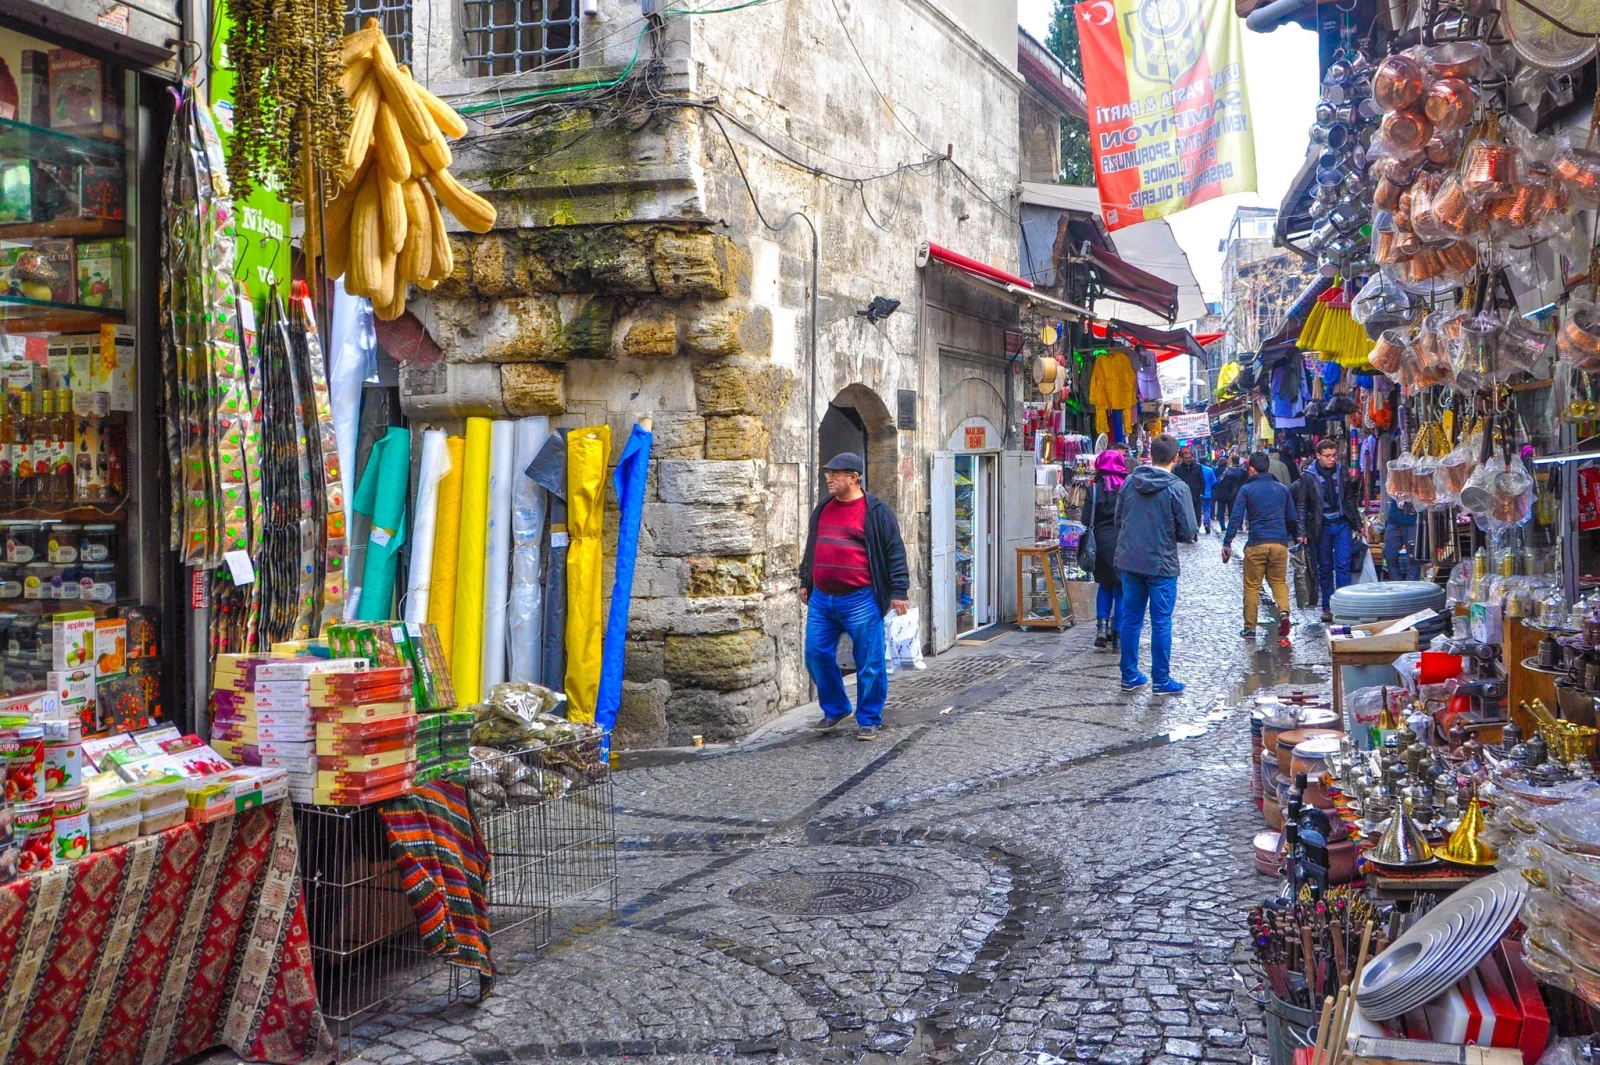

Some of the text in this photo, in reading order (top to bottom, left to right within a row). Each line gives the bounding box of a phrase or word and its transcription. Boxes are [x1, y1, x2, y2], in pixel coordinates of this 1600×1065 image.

[66, 621, 85, 631] apple
[98, 627, 118, 635] orange
[69, 683, 86, 692] Rose
